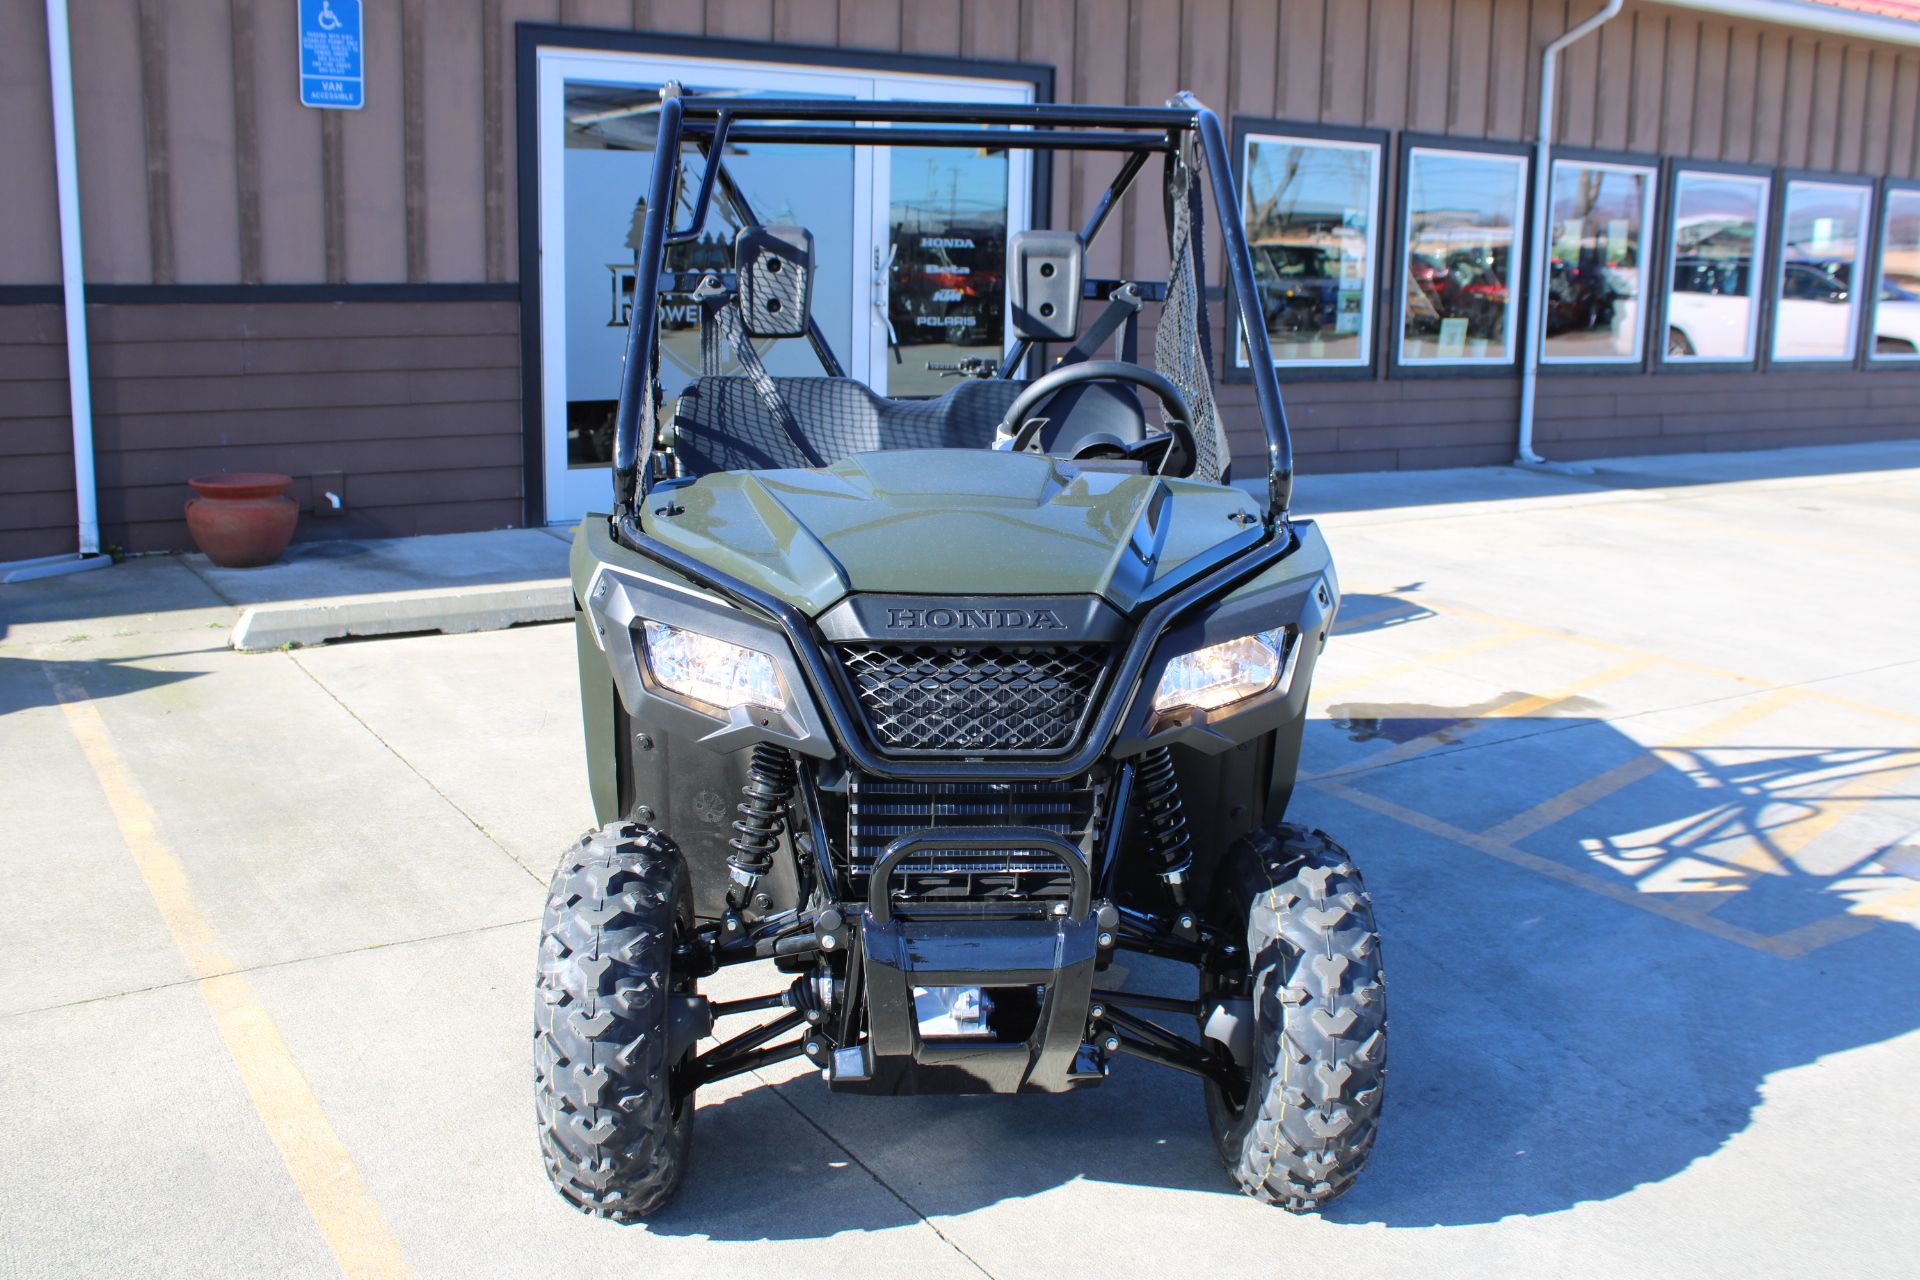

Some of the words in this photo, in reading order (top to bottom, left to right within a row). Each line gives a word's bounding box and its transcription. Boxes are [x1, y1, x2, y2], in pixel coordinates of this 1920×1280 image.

[321, 81, 344, 92] VAN
[310, 91, 354, 101] ACCESSIBLE
[920, 237, 976, 249] HONDA
[916, 316, 977, 327] POLARIS
[887, 608, 1068, 630] HONDA
